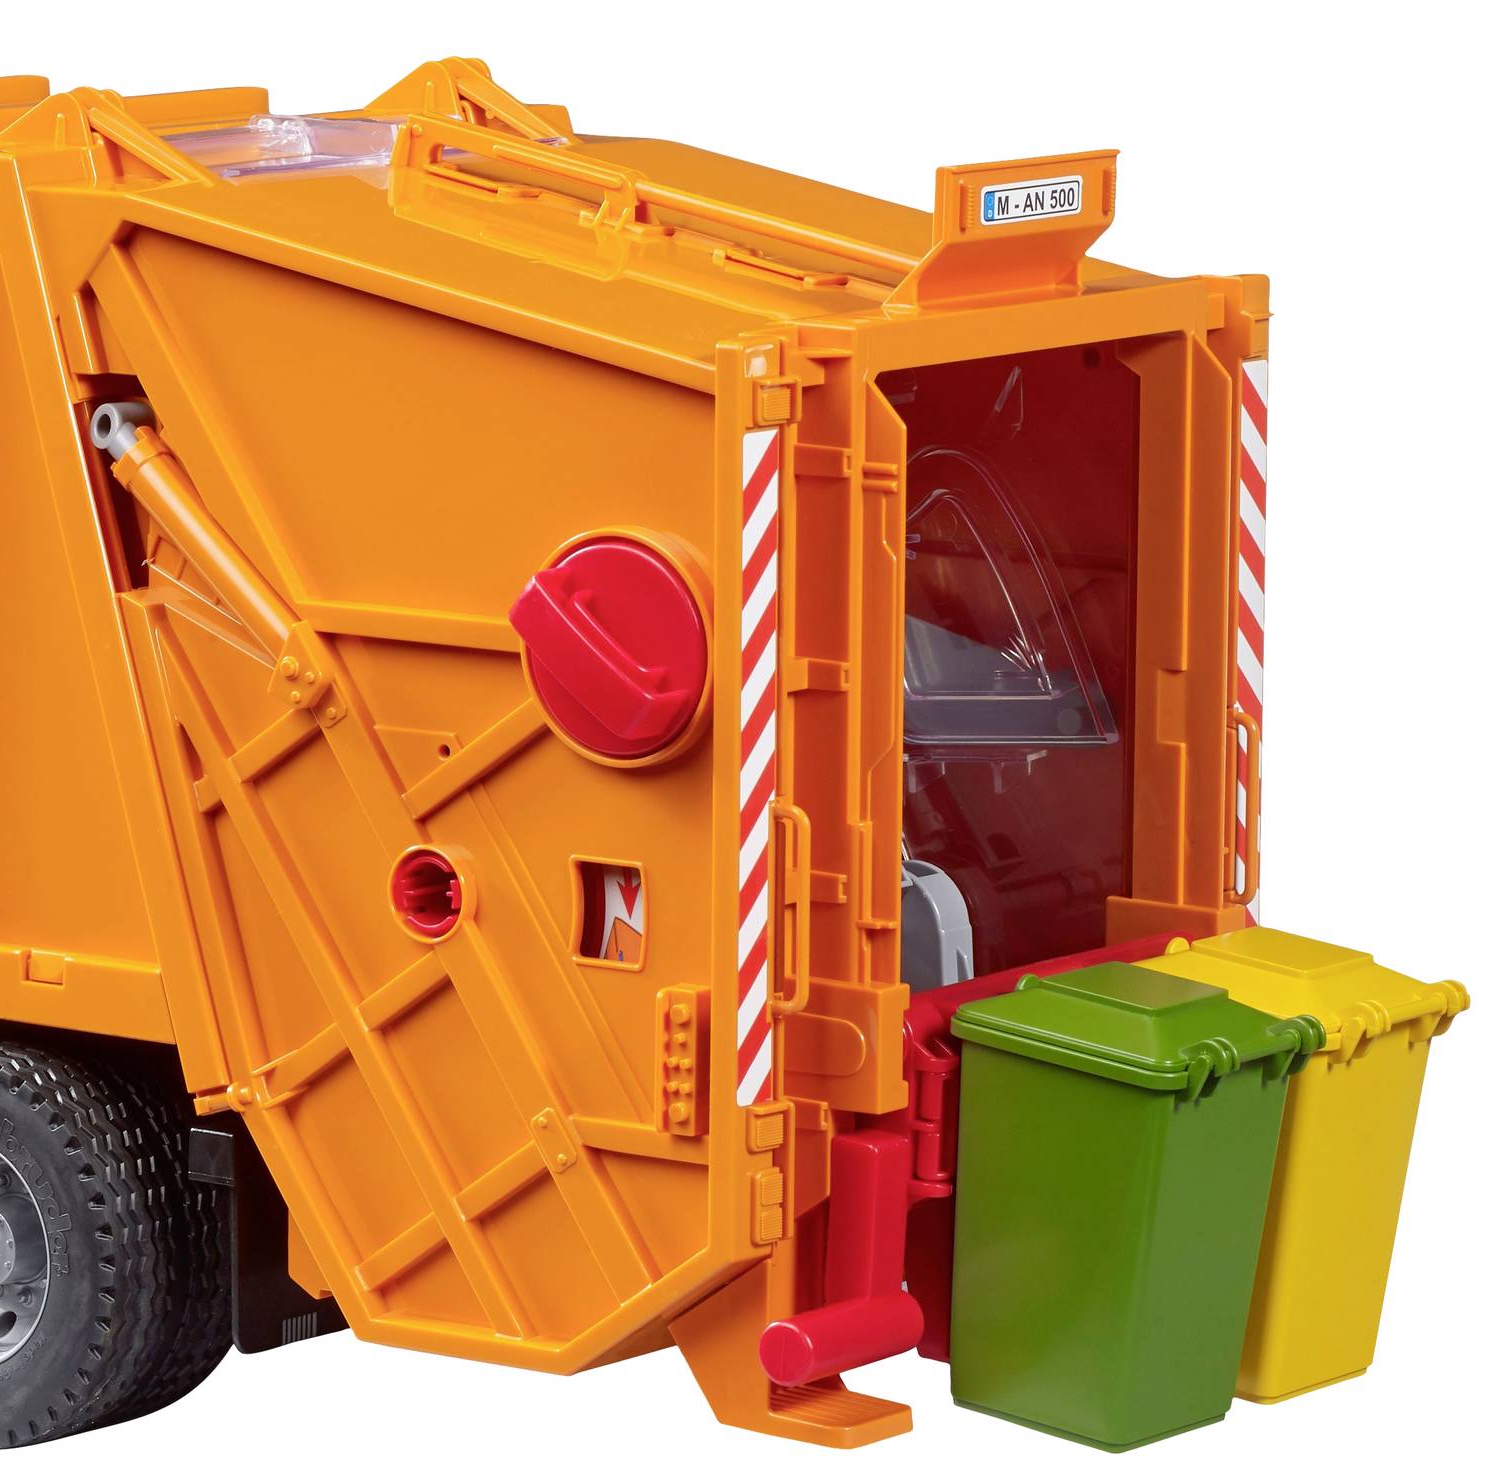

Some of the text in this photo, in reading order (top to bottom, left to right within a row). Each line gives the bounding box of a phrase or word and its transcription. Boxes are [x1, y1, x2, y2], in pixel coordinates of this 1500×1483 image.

[997, 195, 1009, 216] M
[1023, 191, 1045, 213] AN
[1050, 187, 1075, 209] 500
[0, 1118, 72, 1277] bruder
